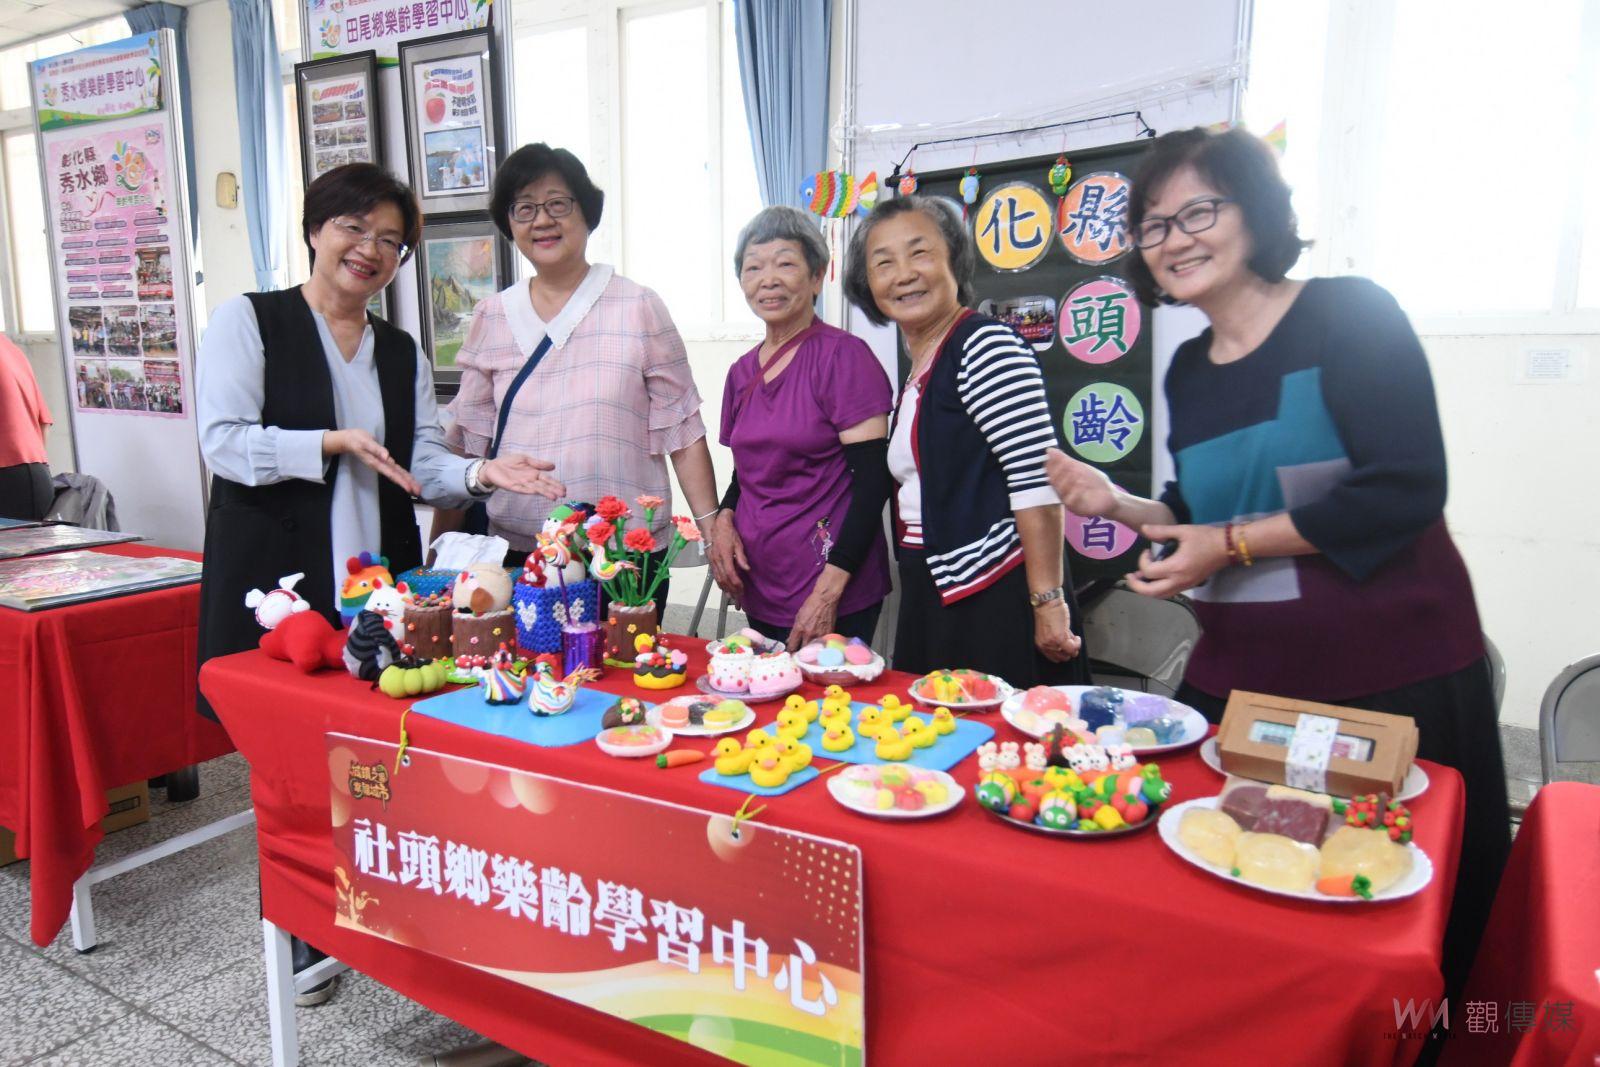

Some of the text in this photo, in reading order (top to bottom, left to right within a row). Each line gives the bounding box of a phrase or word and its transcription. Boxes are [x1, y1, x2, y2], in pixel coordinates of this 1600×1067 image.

[346, 0, 468, 43] 田尾鄉樂齡學習中心
[61, 66, 145, 103] 秀水鄉樂齡學習中心
[59, 163, 109, 194] 秀水鄉
[1063, 292, 1129, 355] 頭
[1072, 393, 1140, 451] 齡
[353, 817, 838, 1017] 社頭鄉樂齡學習中心
